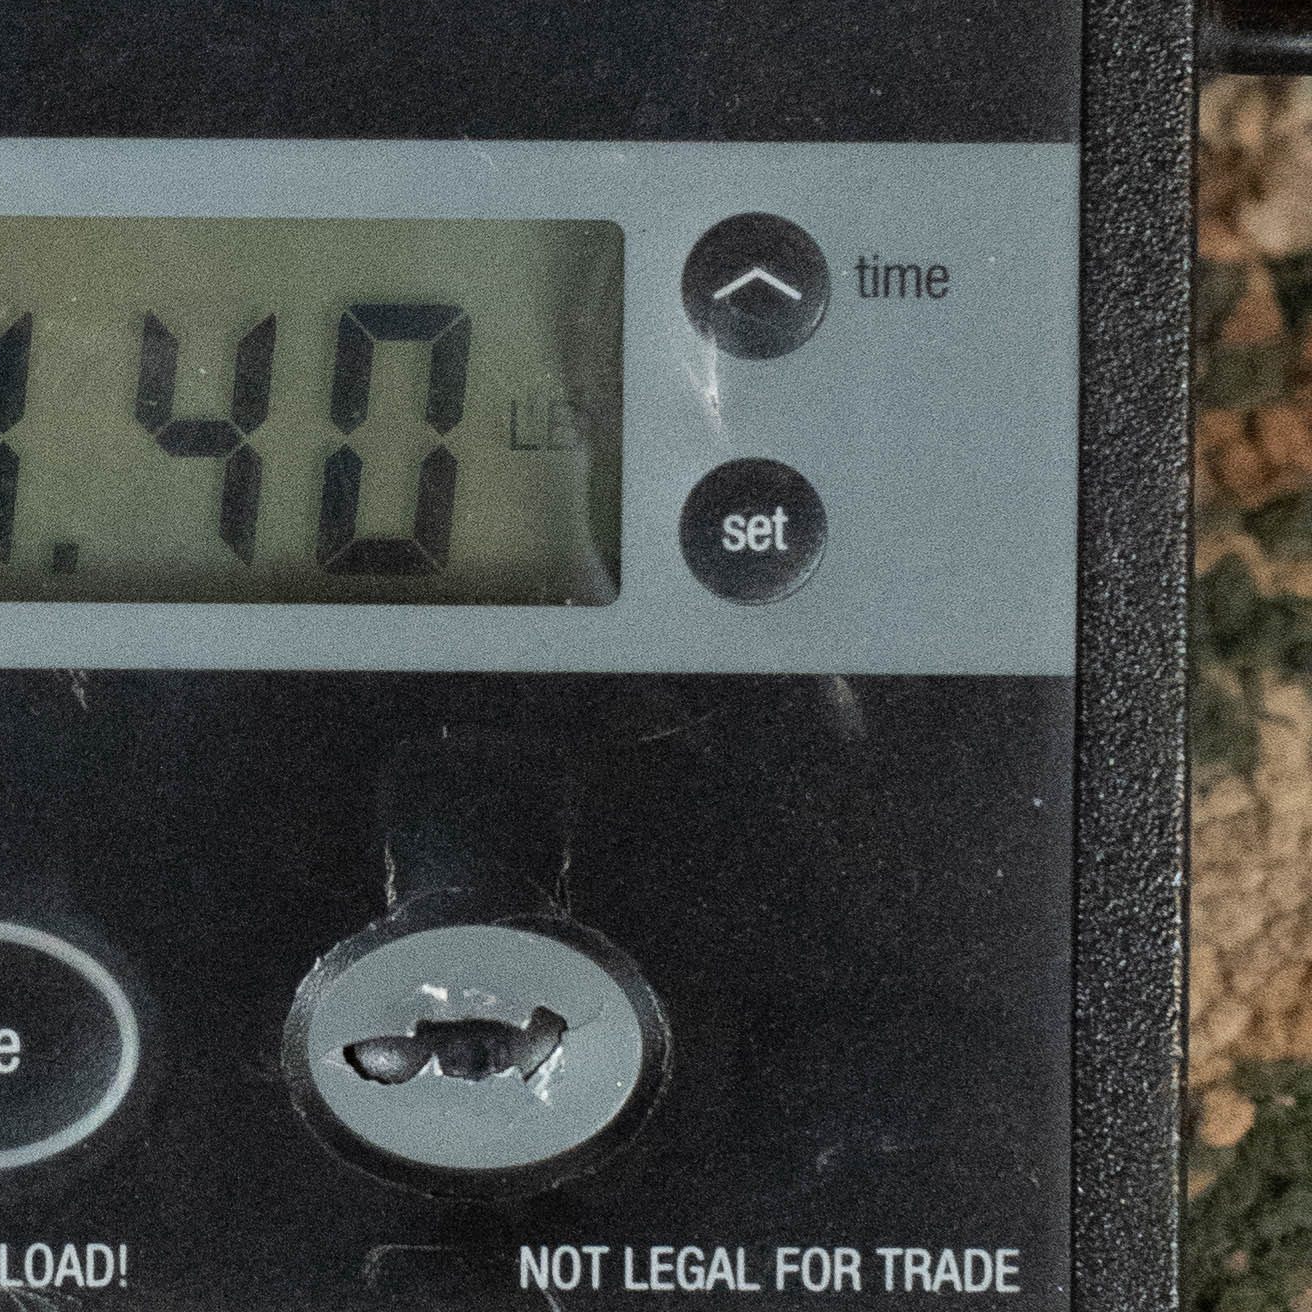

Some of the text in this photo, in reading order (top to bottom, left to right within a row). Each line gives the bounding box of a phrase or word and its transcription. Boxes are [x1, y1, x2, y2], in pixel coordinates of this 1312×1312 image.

[854, 254, 950, 299] time
[721, 506, 790, 553] set
[519, 1245, 1020, 1293] NOT LEGAL FOR TRADE
